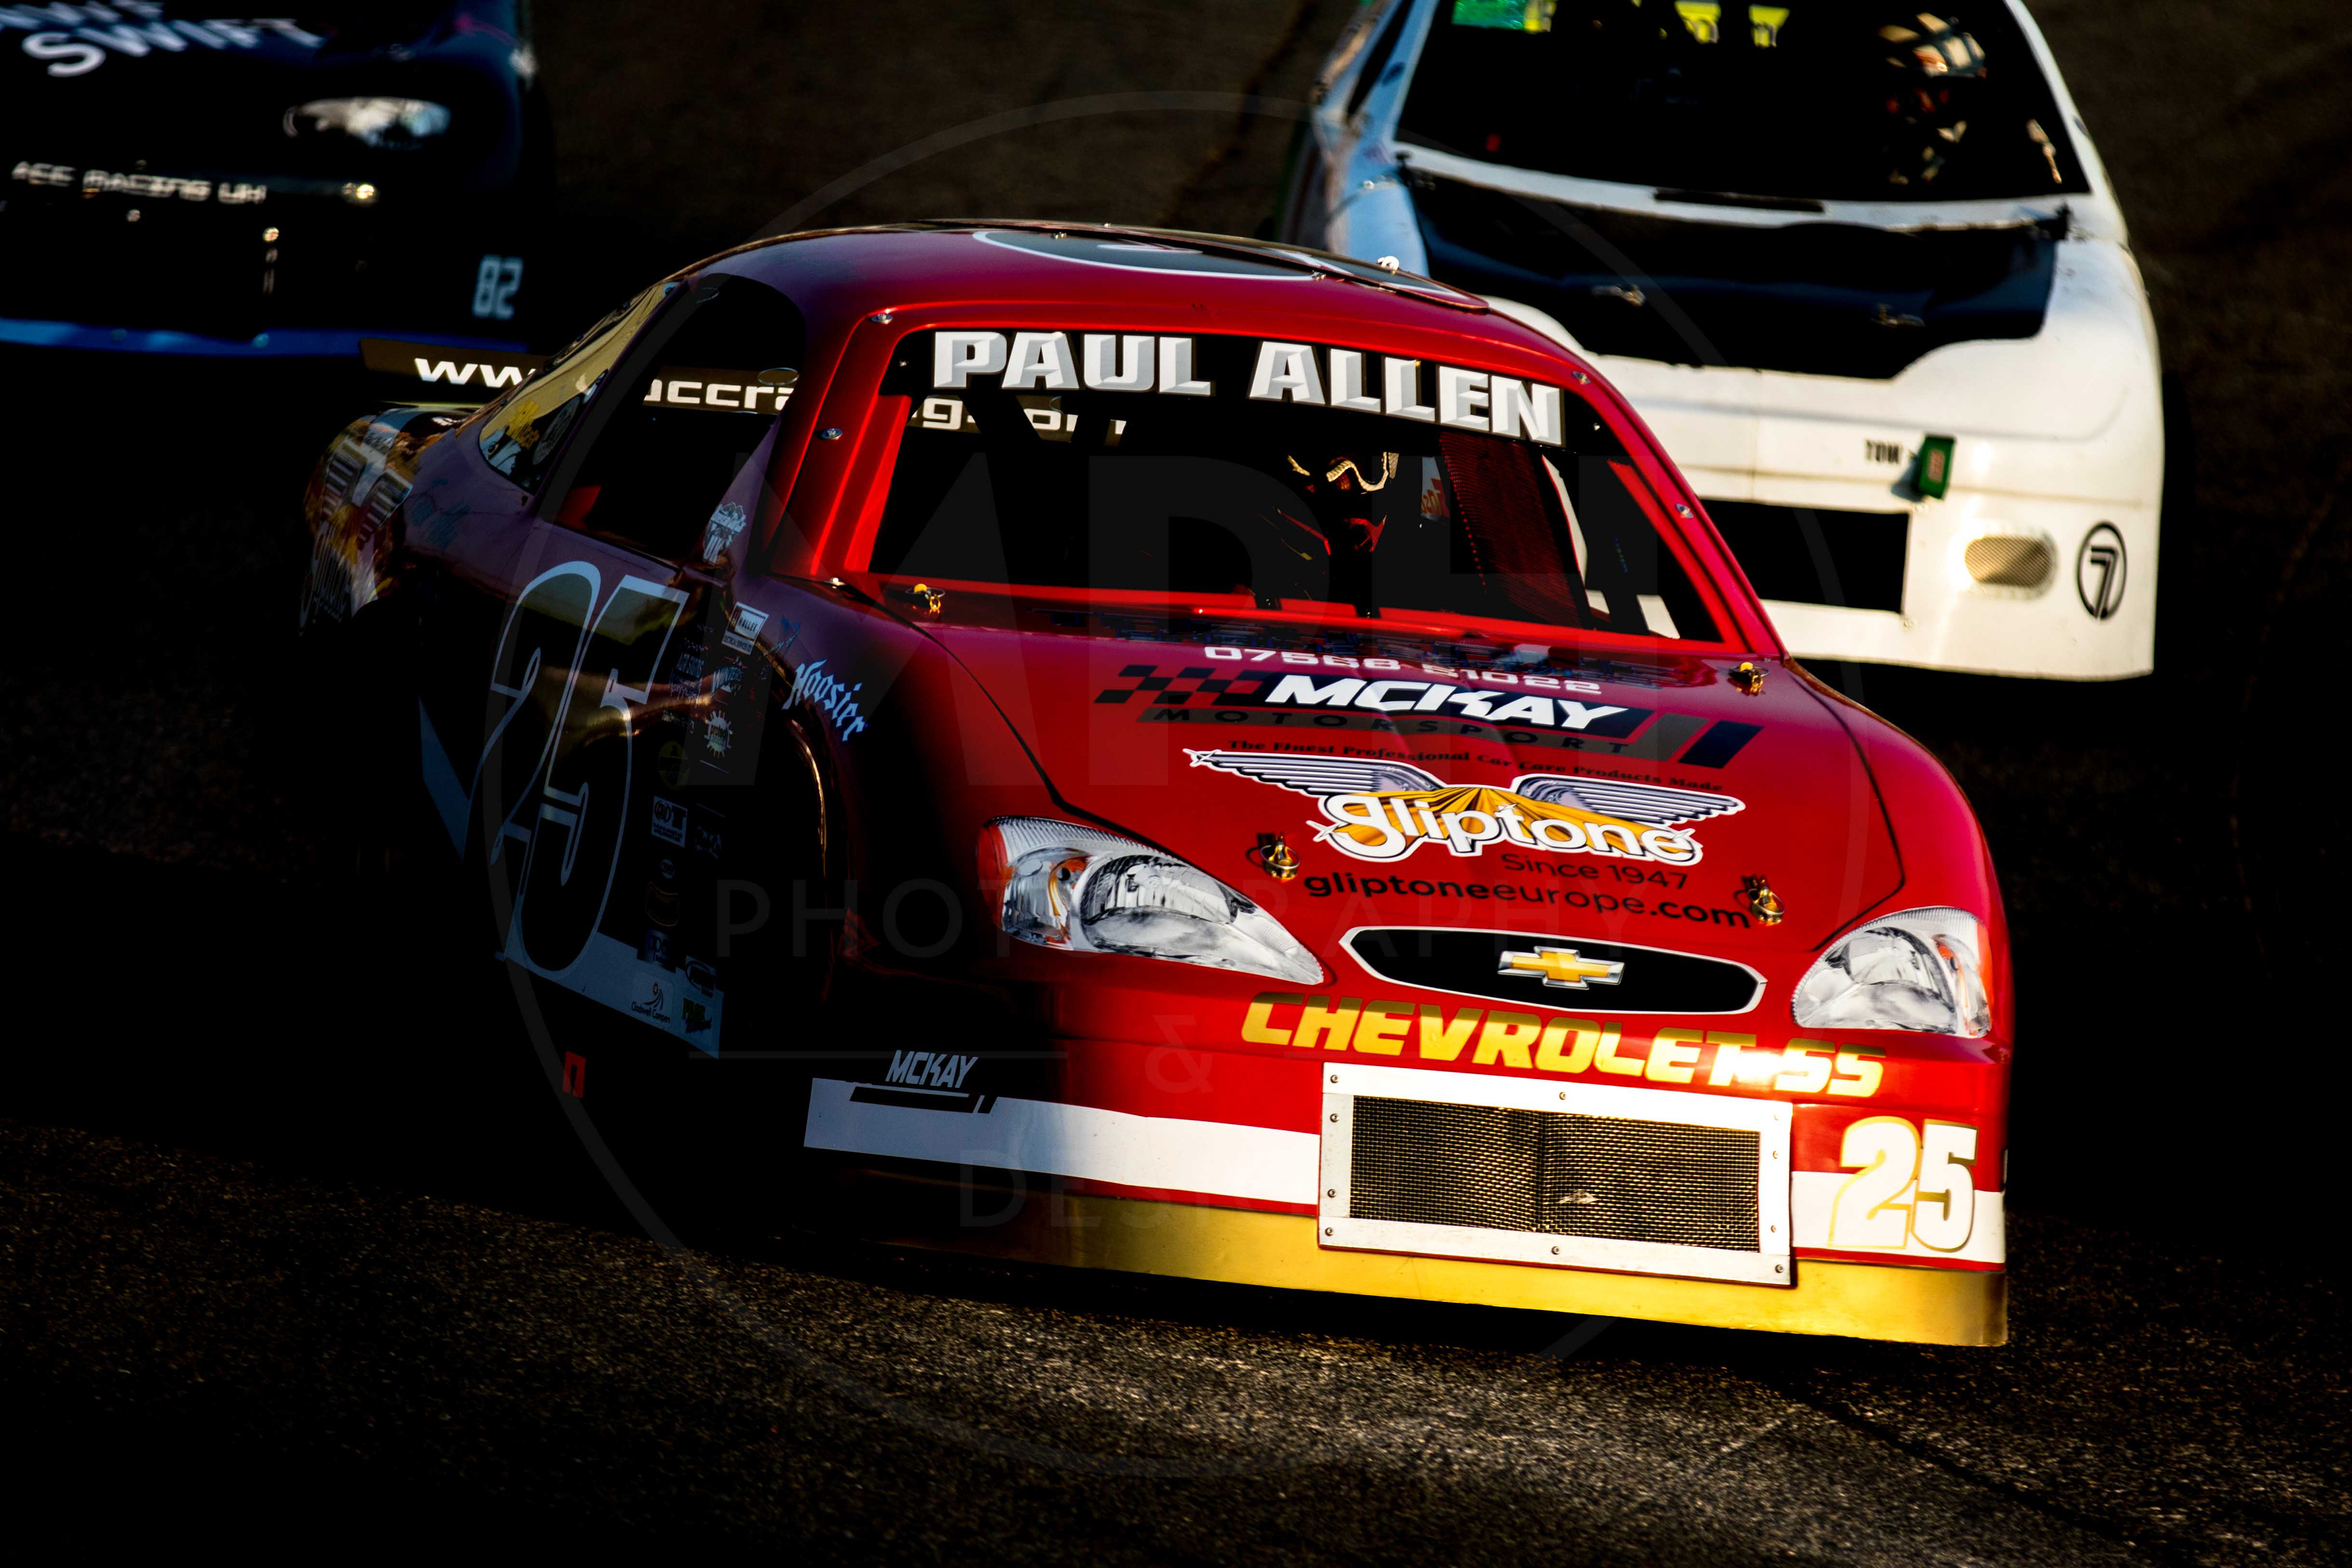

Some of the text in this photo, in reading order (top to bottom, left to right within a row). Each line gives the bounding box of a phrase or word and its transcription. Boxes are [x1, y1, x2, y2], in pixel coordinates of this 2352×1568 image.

[20, 17, 325, 78] SWIFT
[471, 253, 524, 321] 82
[932, 330, 1564, 447] PAUL ALLEN
[780, 658, 867, 742] Hoosier
[1265, 674, 1629, 730] MCKAY
[1153, 707, 1630, 755] MOTORSPORT
[1227, 739, 1723, 792] The Finest Professional Car Care Products Made
[1323, 793, 1700, 864] gliptone
[1303, 872, 1751, 929] gliptoneeurope.com
[1501, 853, 1689, 891] Since 1947
[885, 1049, 979, 1089] MCKAY
[1240, 992, 1757, 1087] CHEVROLET
[1827, 1116, 1978, 1253] 25
